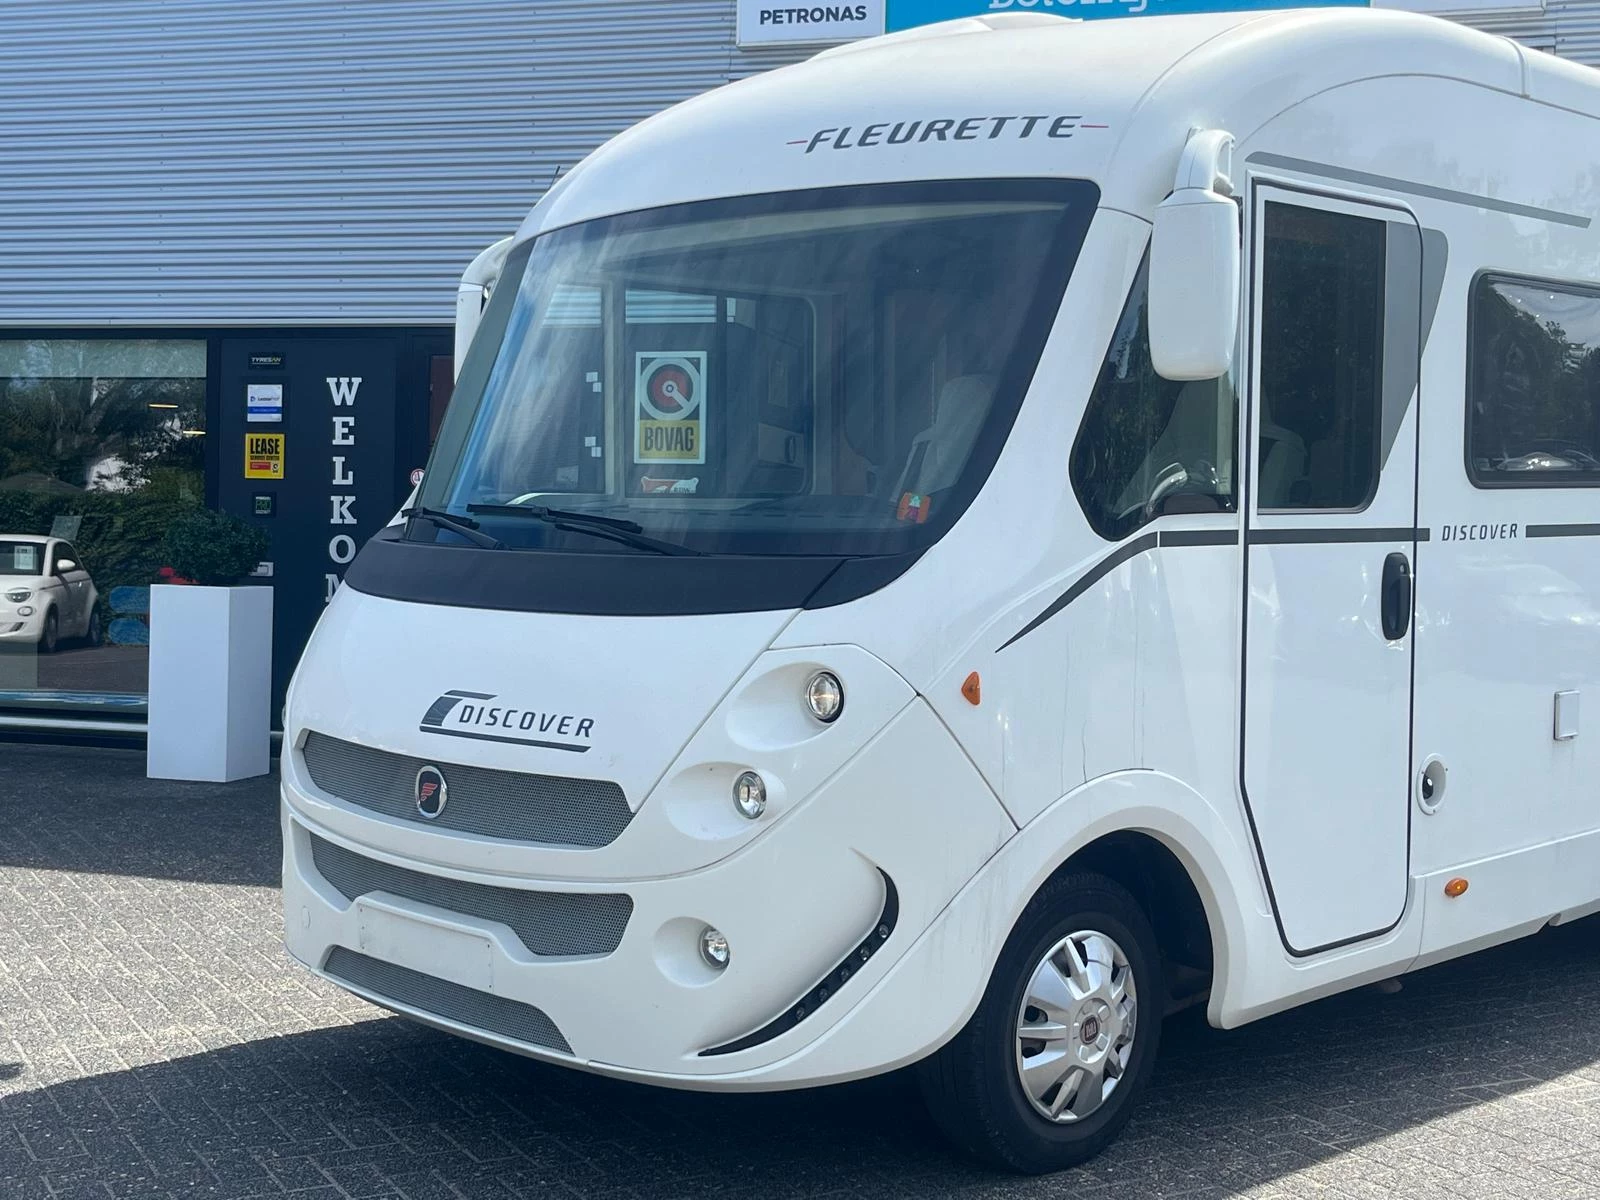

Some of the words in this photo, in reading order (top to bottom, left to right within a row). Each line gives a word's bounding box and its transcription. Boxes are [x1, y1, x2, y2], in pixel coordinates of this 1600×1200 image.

[759, 5, 867, 25] PETRONAS
[804, 115, 1083, 154] FLEURETTE
[250, 438, 280, 454] LEASE
[644, 426, 694, 452] BOVAG
[1441, 523, 1518, 542] DISCOVER
[458, 704, 595, 738] DISCOVER
